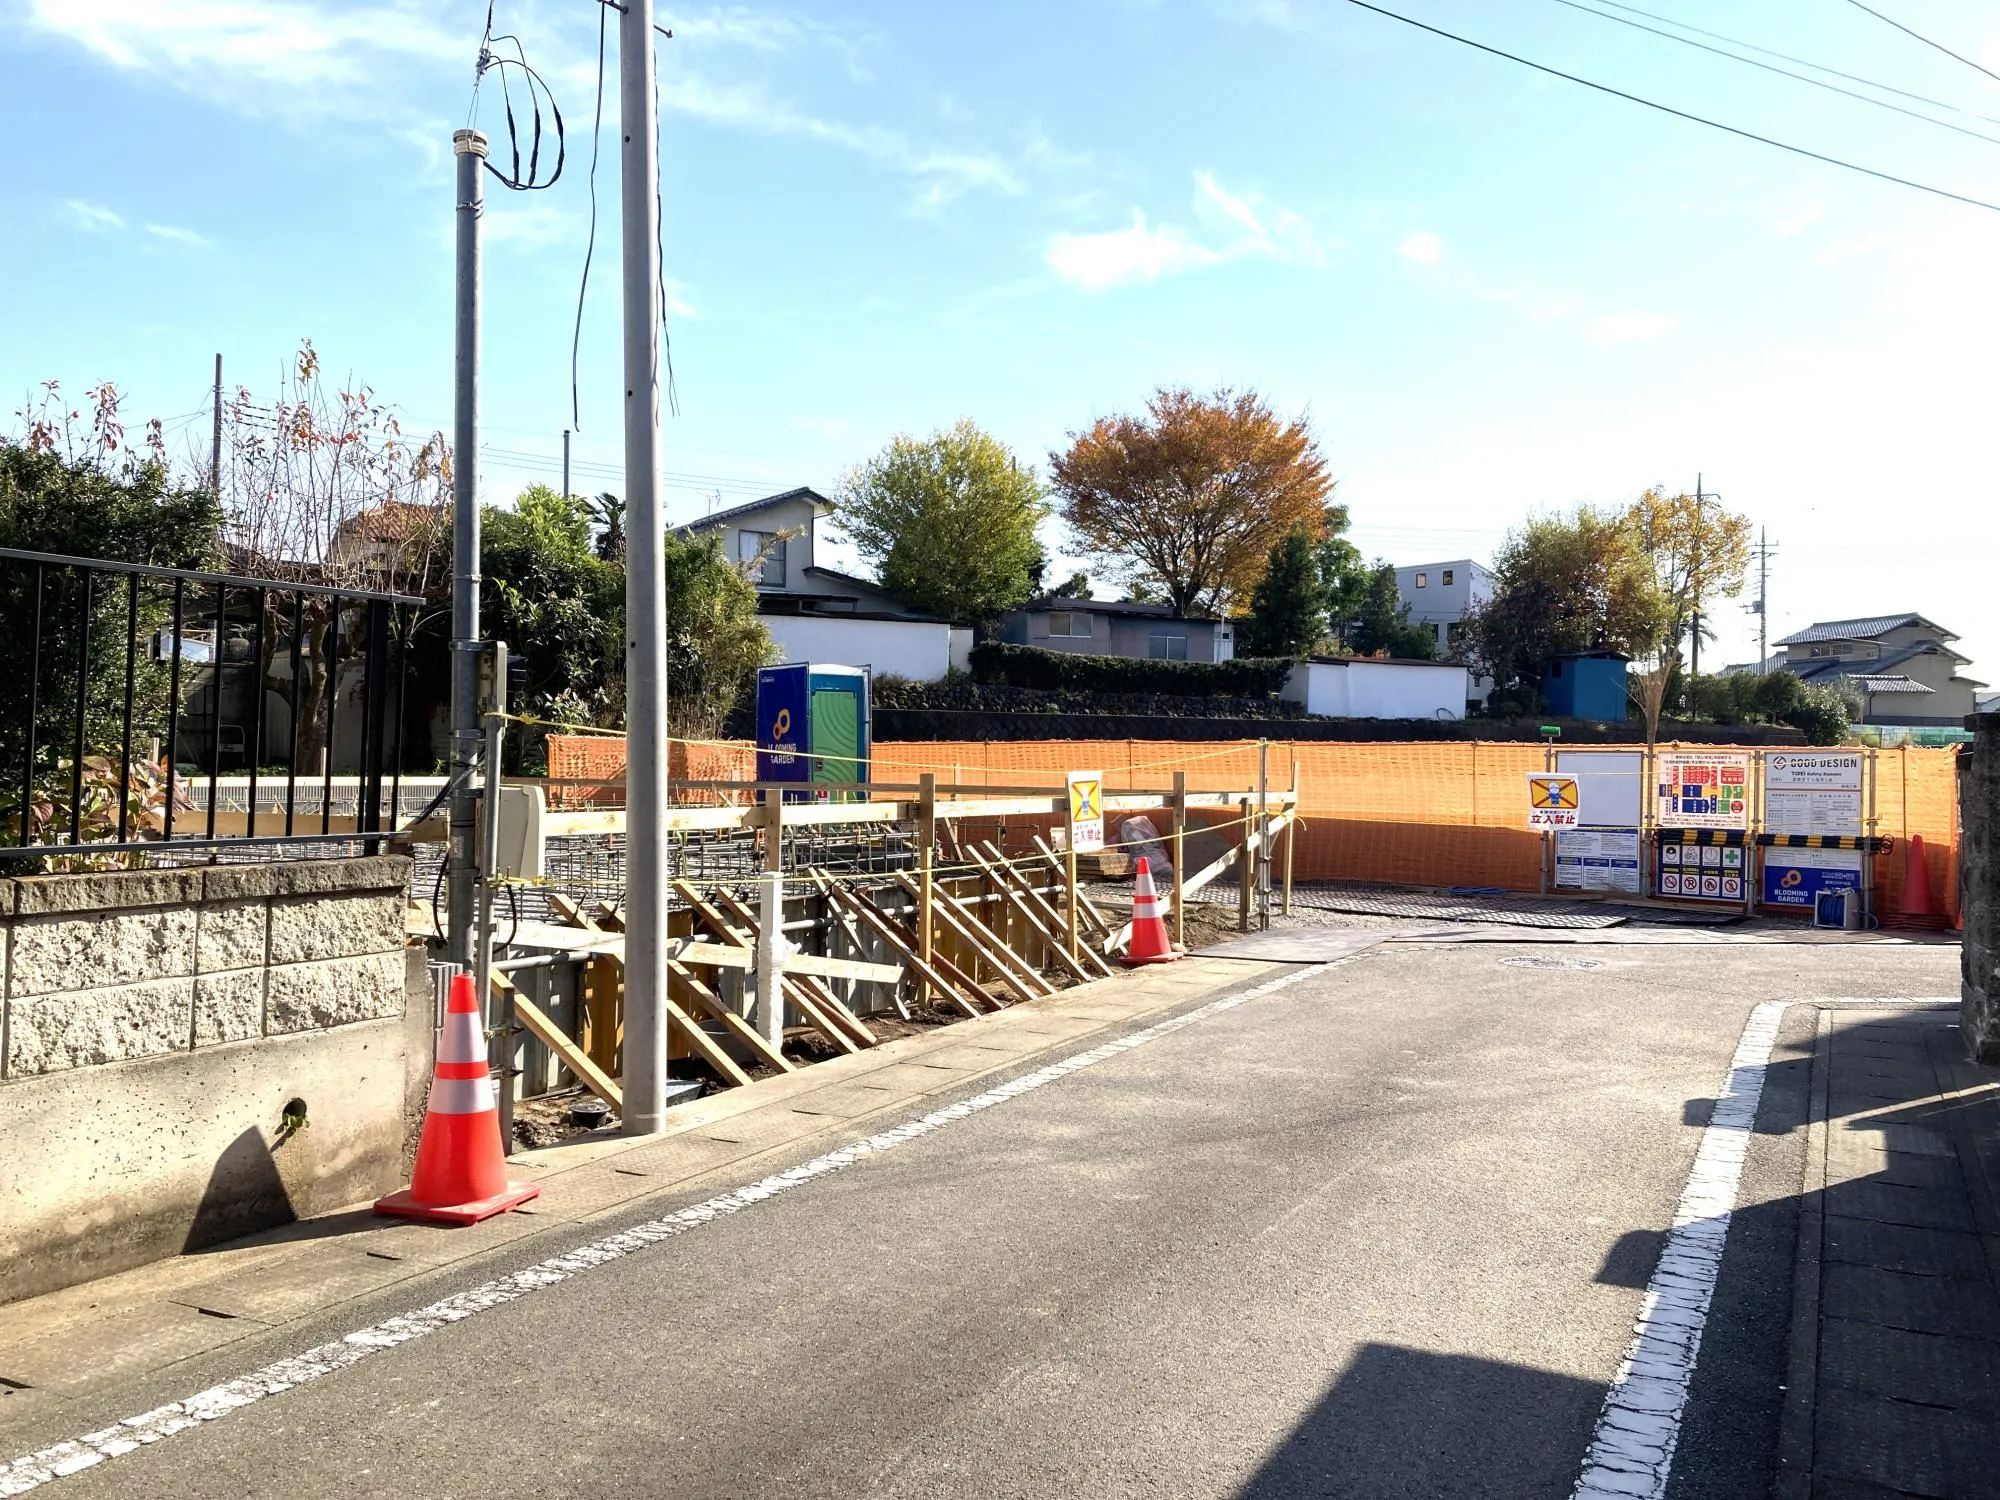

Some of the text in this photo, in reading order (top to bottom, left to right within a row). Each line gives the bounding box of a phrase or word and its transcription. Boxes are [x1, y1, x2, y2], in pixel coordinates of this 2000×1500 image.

[1790, 758, 1857, 768] GOOD DESIGN
[1530, 814, 1576, 824] 立入禁止
[1774, 889, 1809, 897] BLOOMING
